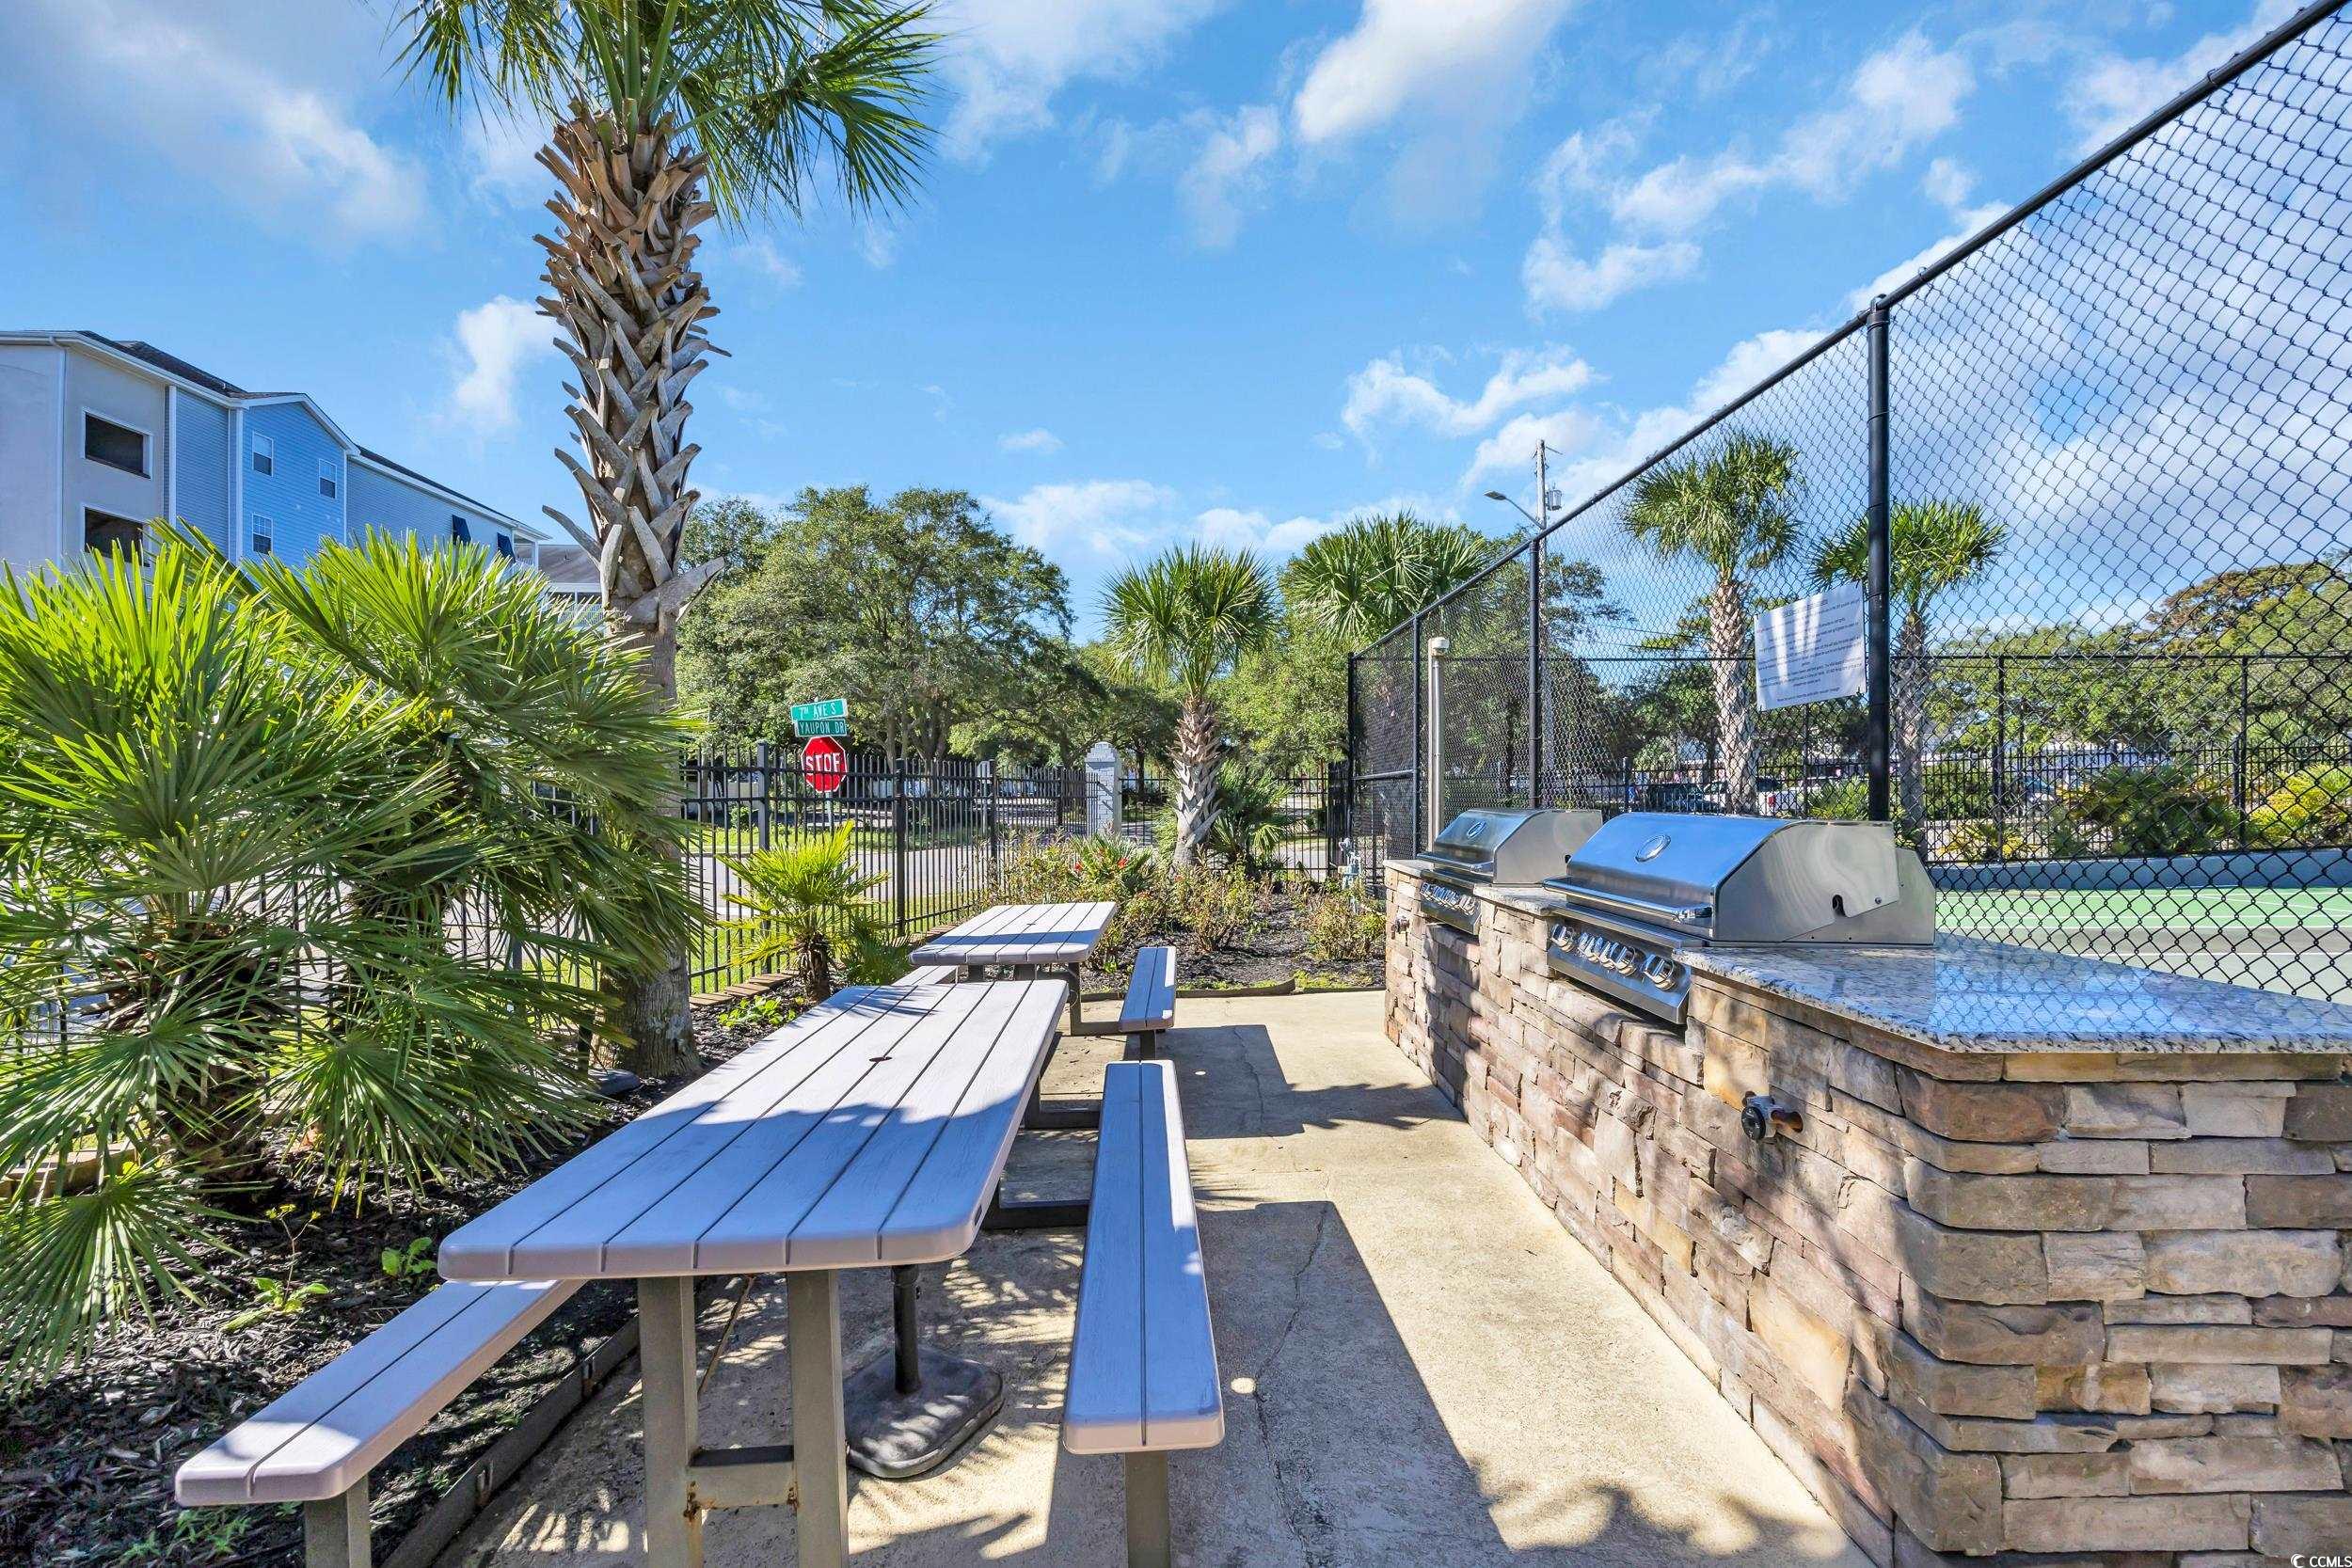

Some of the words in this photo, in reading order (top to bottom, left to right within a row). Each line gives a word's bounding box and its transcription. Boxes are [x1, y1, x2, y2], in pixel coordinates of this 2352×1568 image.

[813, 704, 828, 718] AVE
[831, 702, 836, 715] S
[800, 721, 830, 734] YAUPON
[834, 721, 845, 734] DR
